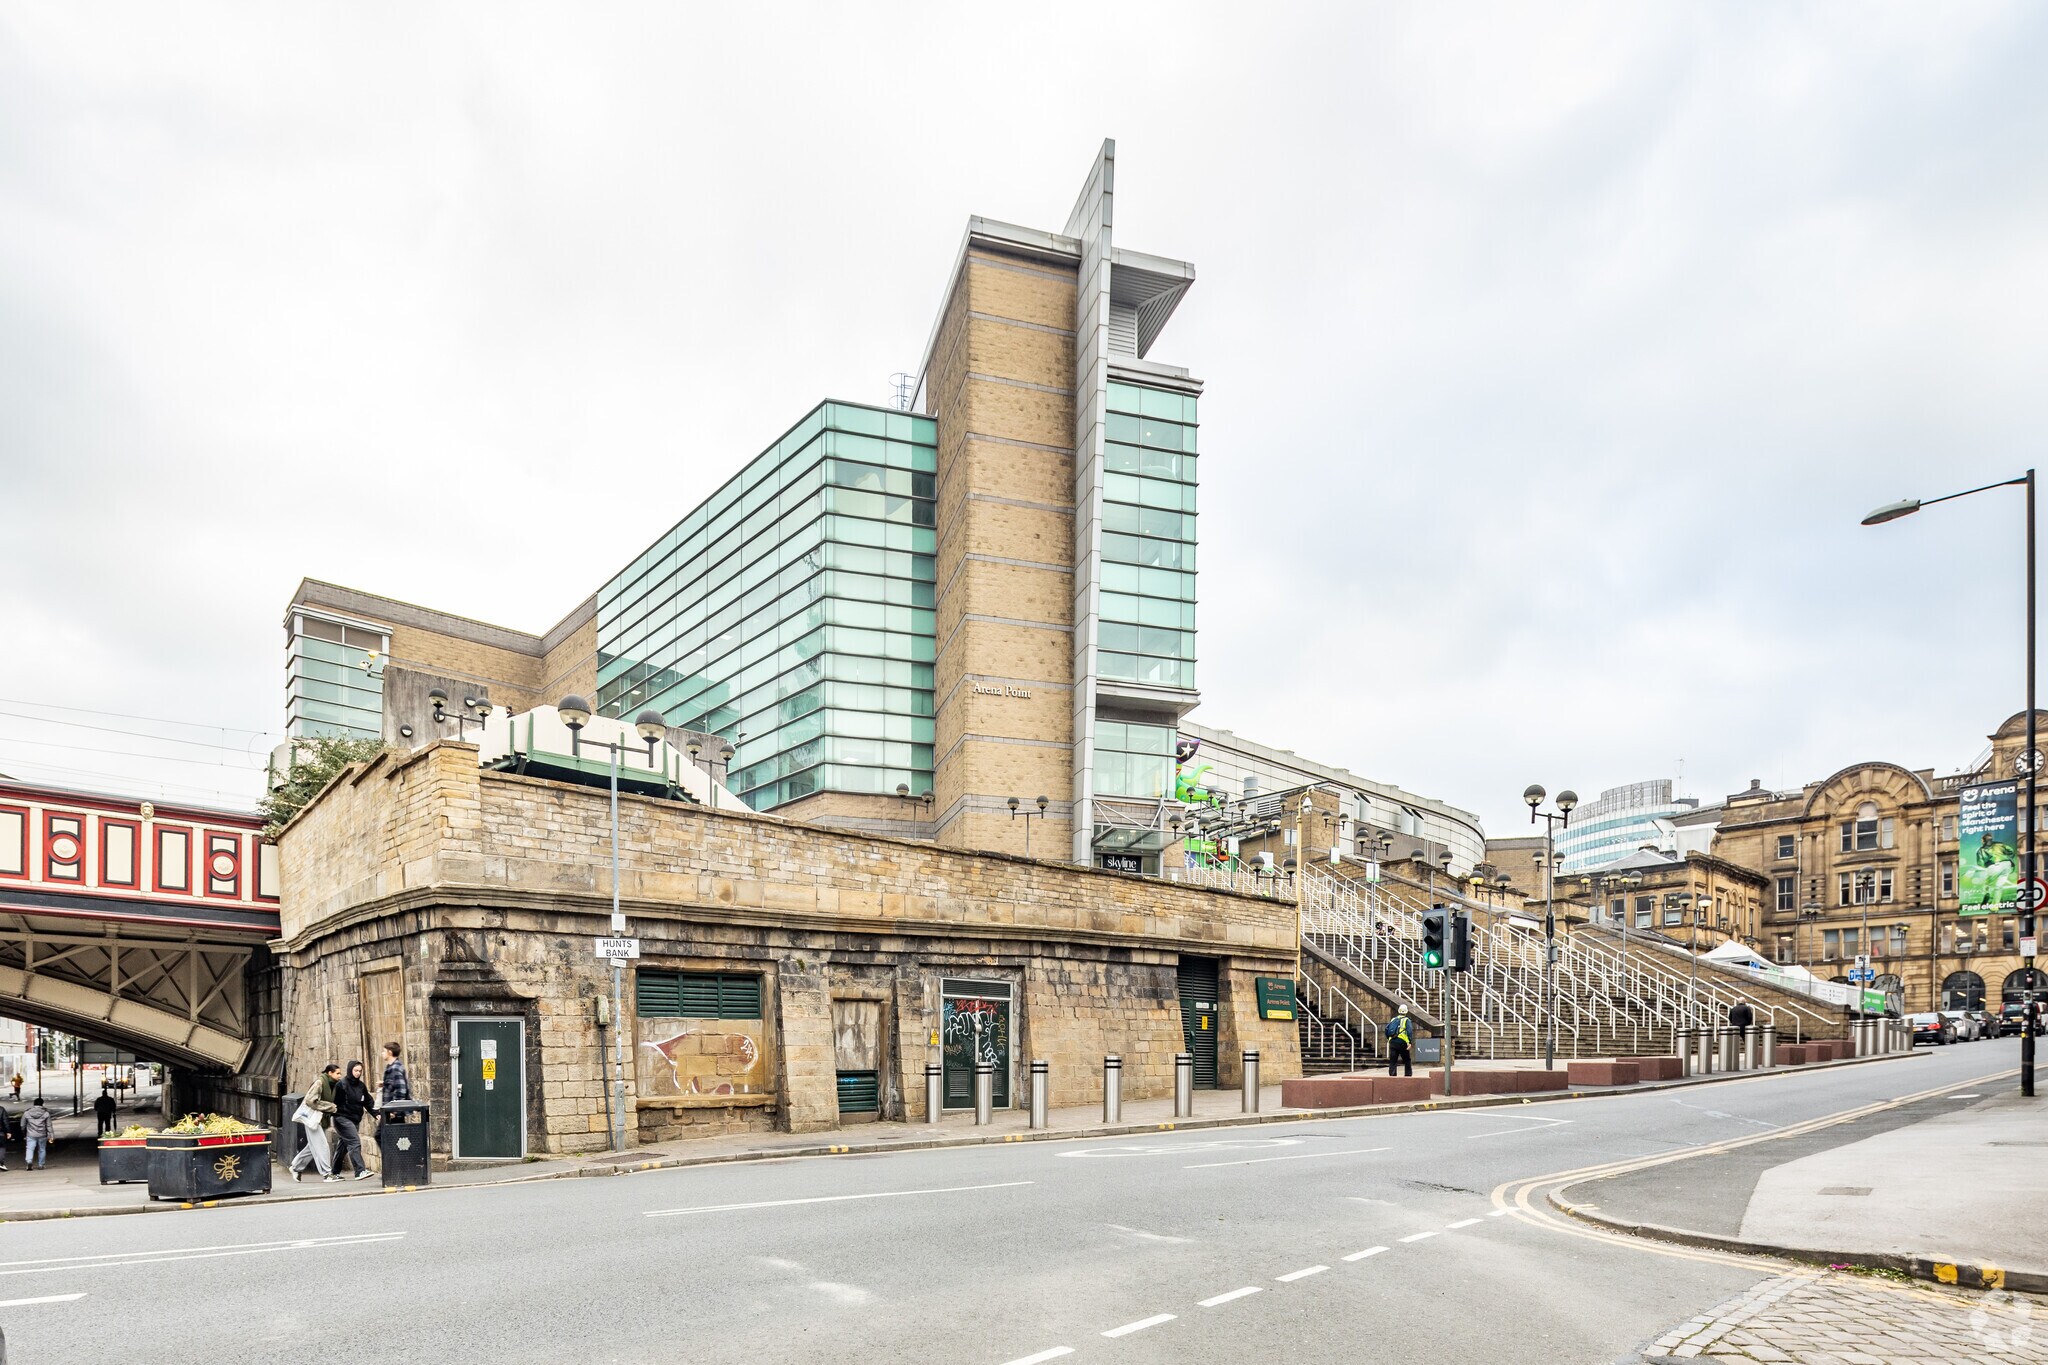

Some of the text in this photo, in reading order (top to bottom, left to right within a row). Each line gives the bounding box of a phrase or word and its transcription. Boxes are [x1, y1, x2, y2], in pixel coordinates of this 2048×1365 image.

[973, 682, 1031, 699] Arena Point
[1980, 786, 2016, 797] Arena
[1962, 802, 1997, 812] Feel the
[1961, 815, 2015, 826] Manchester
[1962, 811, 1986, 820] spirit
[1962, 824, 2005, 835] right here
[1107, 856, 1137, 869] skyline
[1981, 901, 2015, 910] electric
[602, 940, 633, 948] HUNTS
[605, 949, 630, 957] BANK
